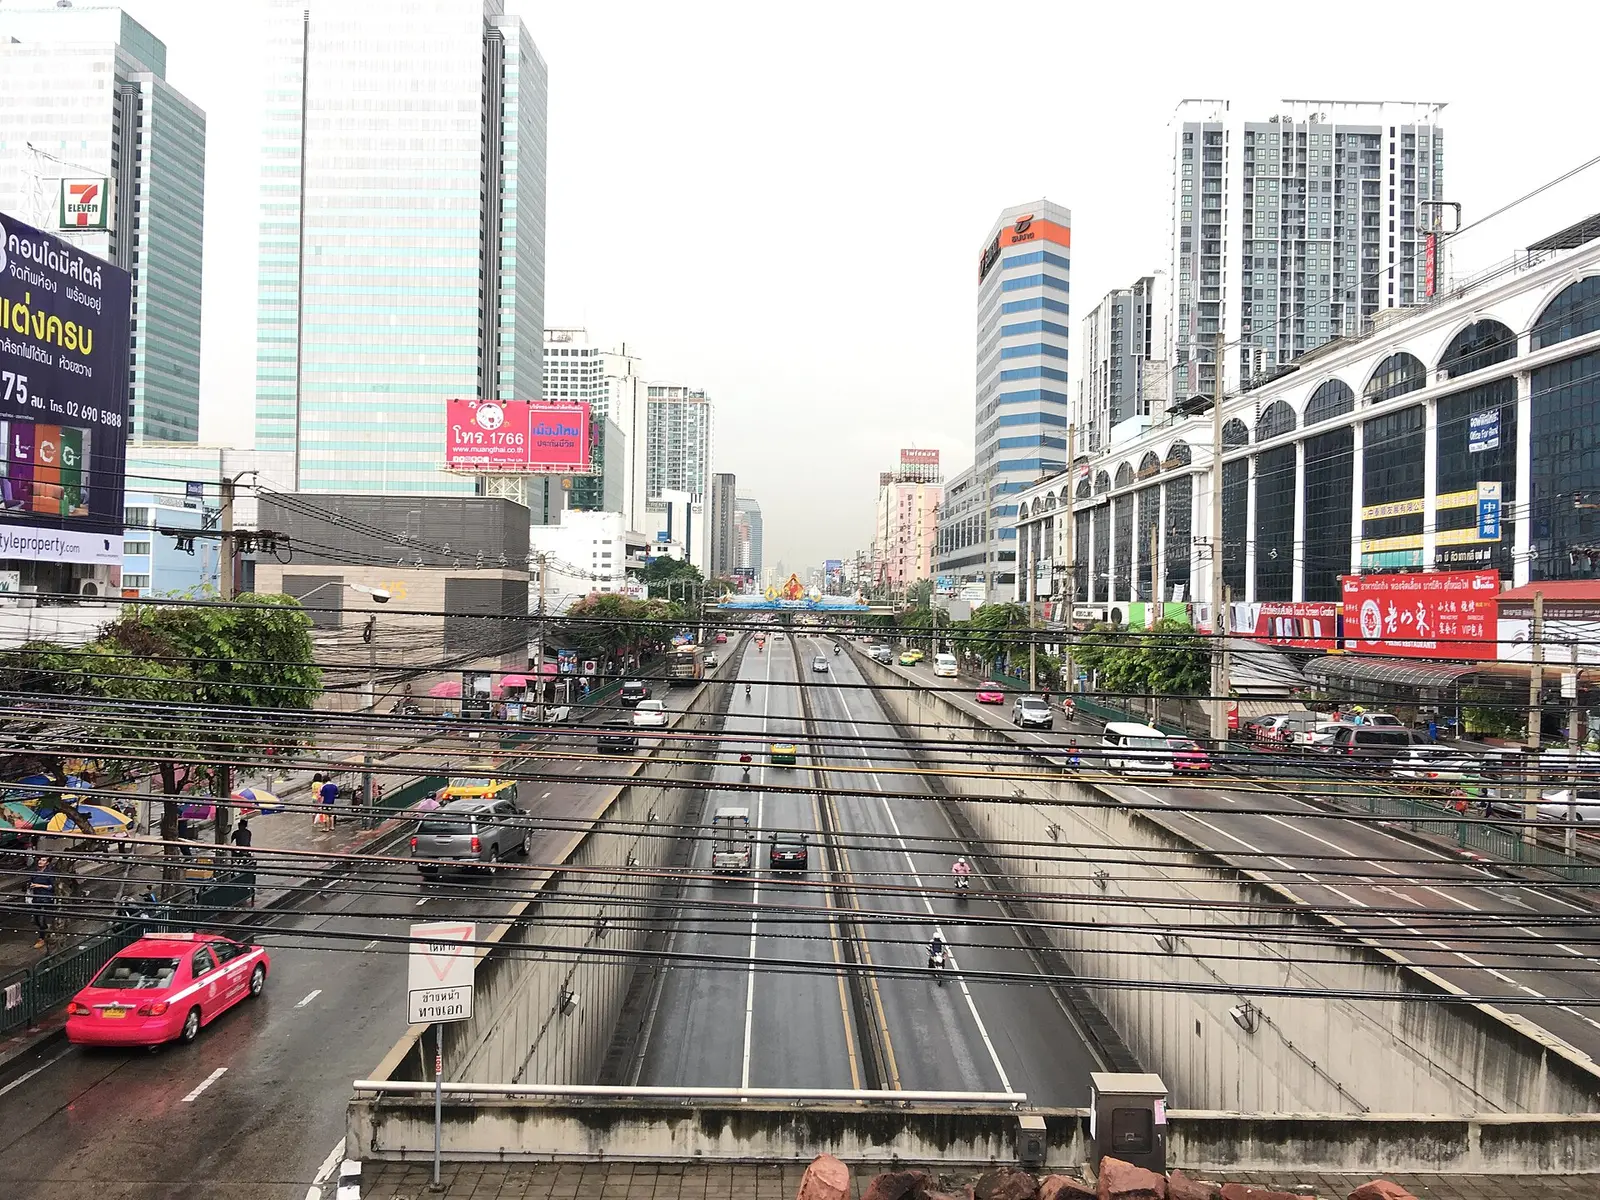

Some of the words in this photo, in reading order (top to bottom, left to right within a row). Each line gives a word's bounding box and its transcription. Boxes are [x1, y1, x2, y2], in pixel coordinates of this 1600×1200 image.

[70, 184, 98, 226] 7
[9, 234, 102, 290] คอนโดมีสไตล์
[66, 286, 102, 316] พร้อมอยู่
[59, 355, 92, 378] ห้วยขวาง
[50, 399, 65, 414] โทร.
[66, 401, 79, 418] 02
[81, 405, 98, 422] 690
[100, 410, 122, 428] 5888
[452, 425, 487, 444] โทร.
[490, 433, 524, 445] 1766
[533, 422, 579, 436] เมืองไทย
[452, 446, 524, 454] www.muangthai.co.th
[422, 989, 460, 1003] ข้างหน้า
[418, 1004, 463, 1017] ทางเอก
